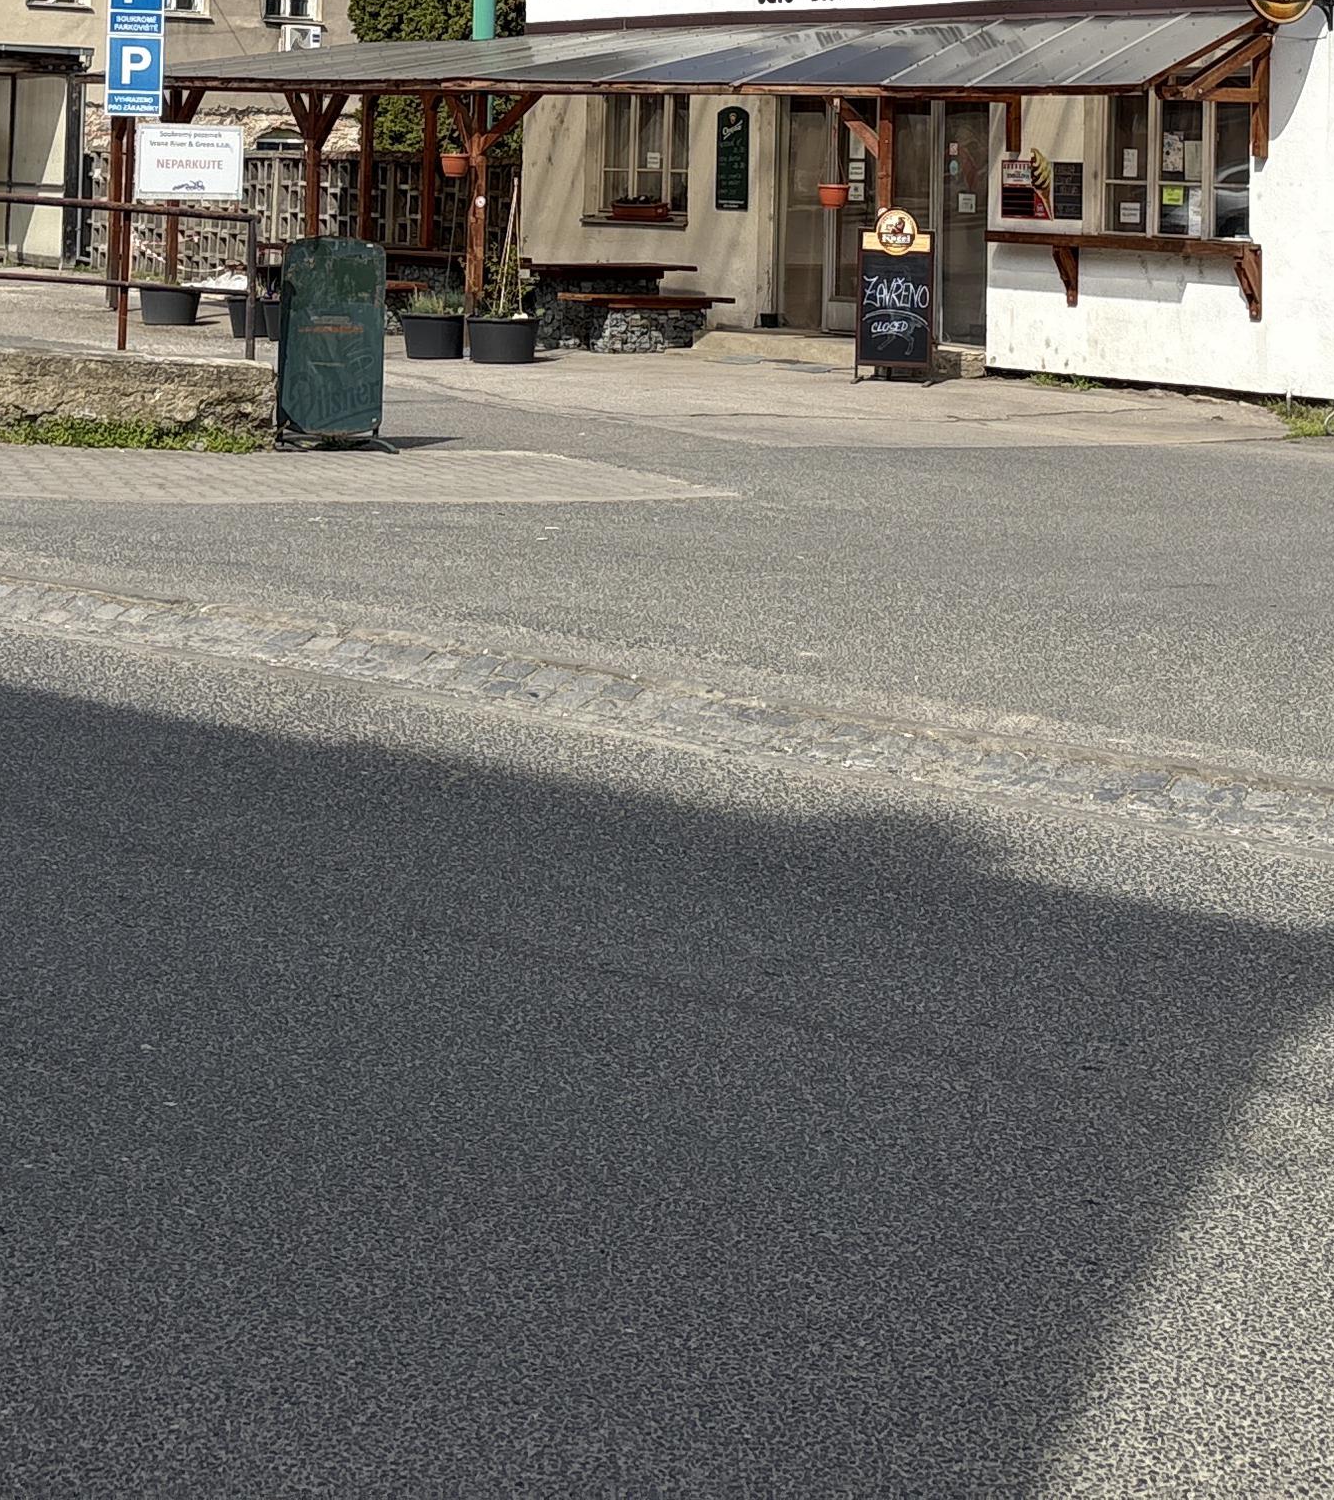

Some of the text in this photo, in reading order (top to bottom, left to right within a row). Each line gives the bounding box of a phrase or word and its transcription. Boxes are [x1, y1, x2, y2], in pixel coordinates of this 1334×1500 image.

[121, 46, 152, 85] P
[156, 158, 224, 171] NEPARKUJTE
[862, 275, 930, 309] ZAVŘENO
[871, 320, 909, 334] CLOSED
